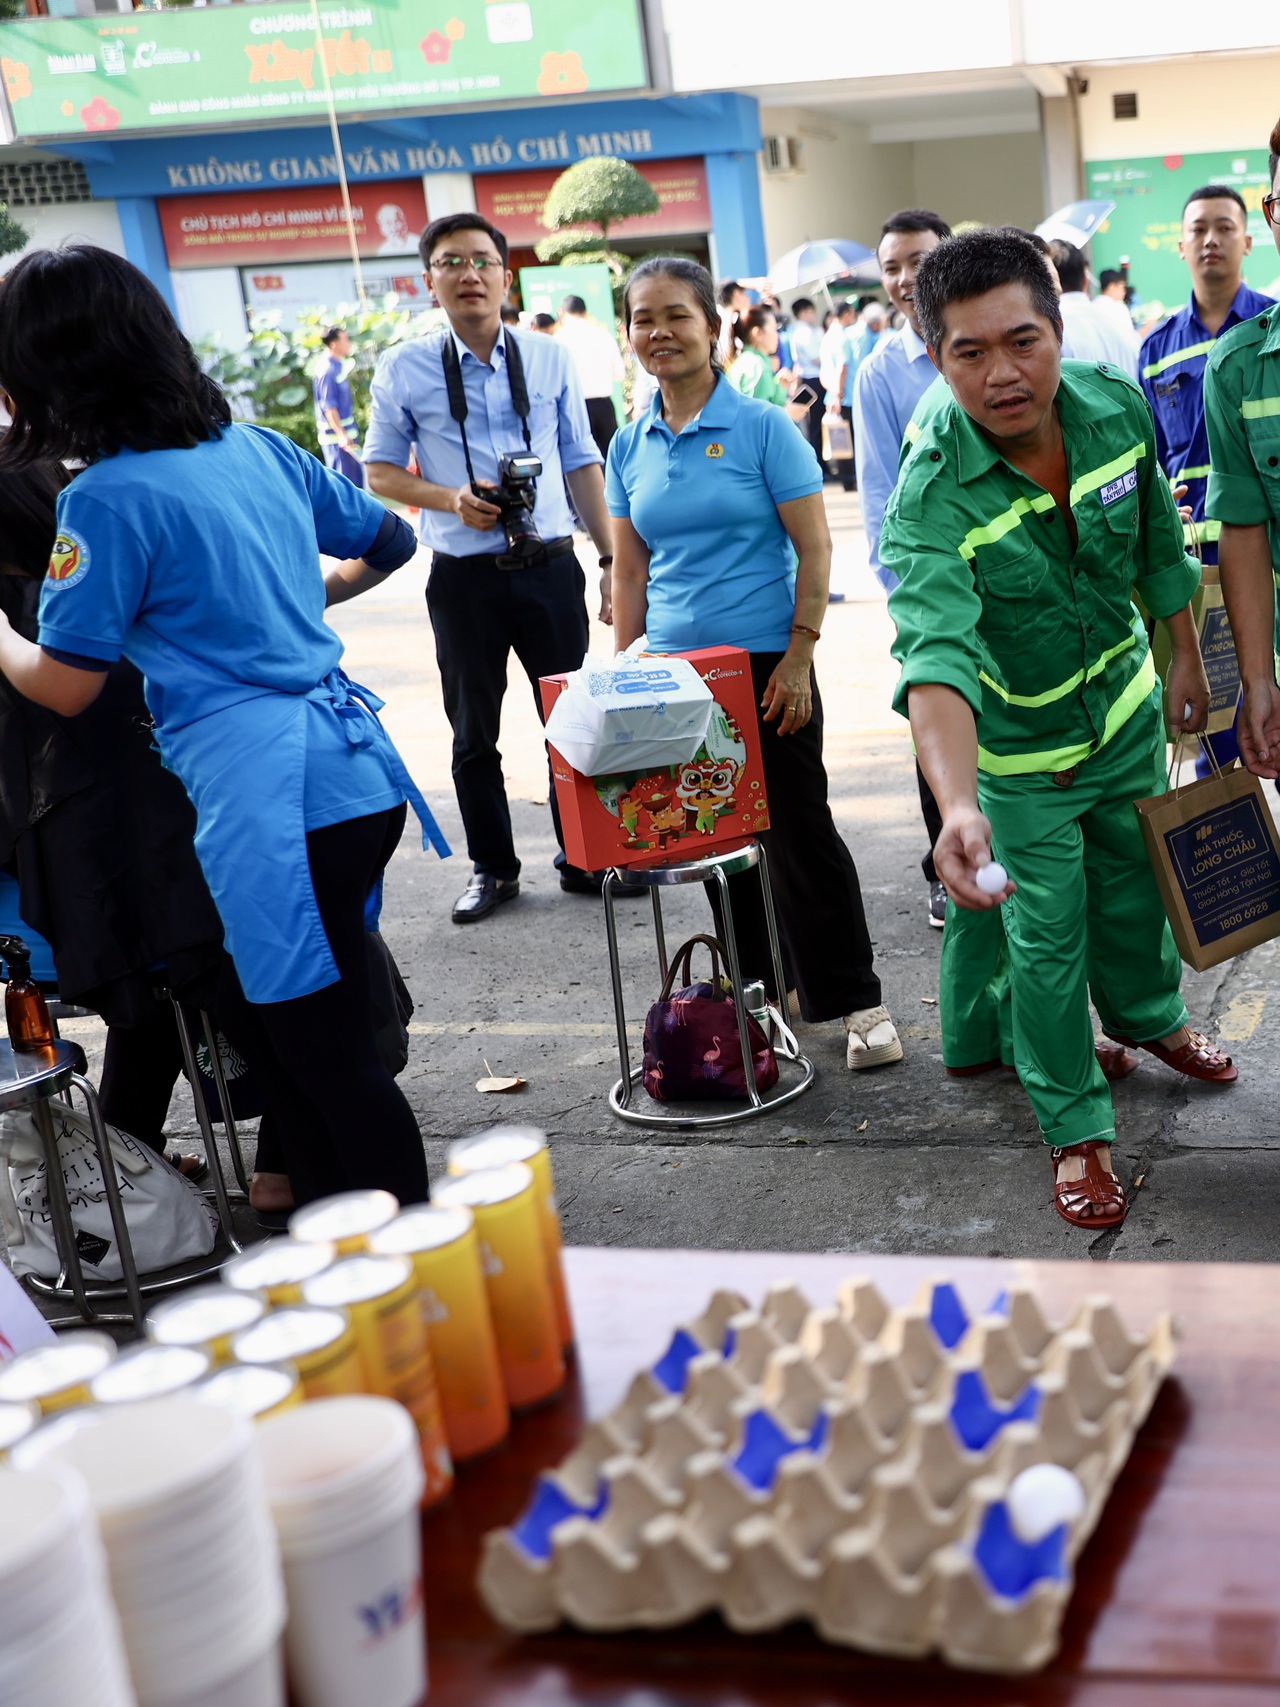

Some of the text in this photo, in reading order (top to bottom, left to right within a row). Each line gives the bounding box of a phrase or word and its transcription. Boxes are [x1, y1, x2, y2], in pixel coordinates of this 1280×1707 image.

[319, 7, 373, 29] TRÌNH
[167, 129, 653, 188] KHÔNG GIAN VĂN HÓA HỒ CHÍ MINH
[180, 212, 208, 232] CHỦ
[210, 211, 240, 232] TỊCH
[263, 207, 286, 227] CHÍ
[287, 207, 323, 225] MINH
[1204, 640, 1236, 655] LONG CHÂ
[1223, 630, 1233, 639] THU
[1191, 837, 1258, 877] LONG CHÂU
[1193, 829, 1245, 859] NHÀ THUỐC
[1192, 859, 1271, 901] Thuốc Tốt Giá Tốt
[1197, 869, 1273, 910] Giao Hàng Tận Nơi
[1220, 901, 1269, 931] 1800 6928
